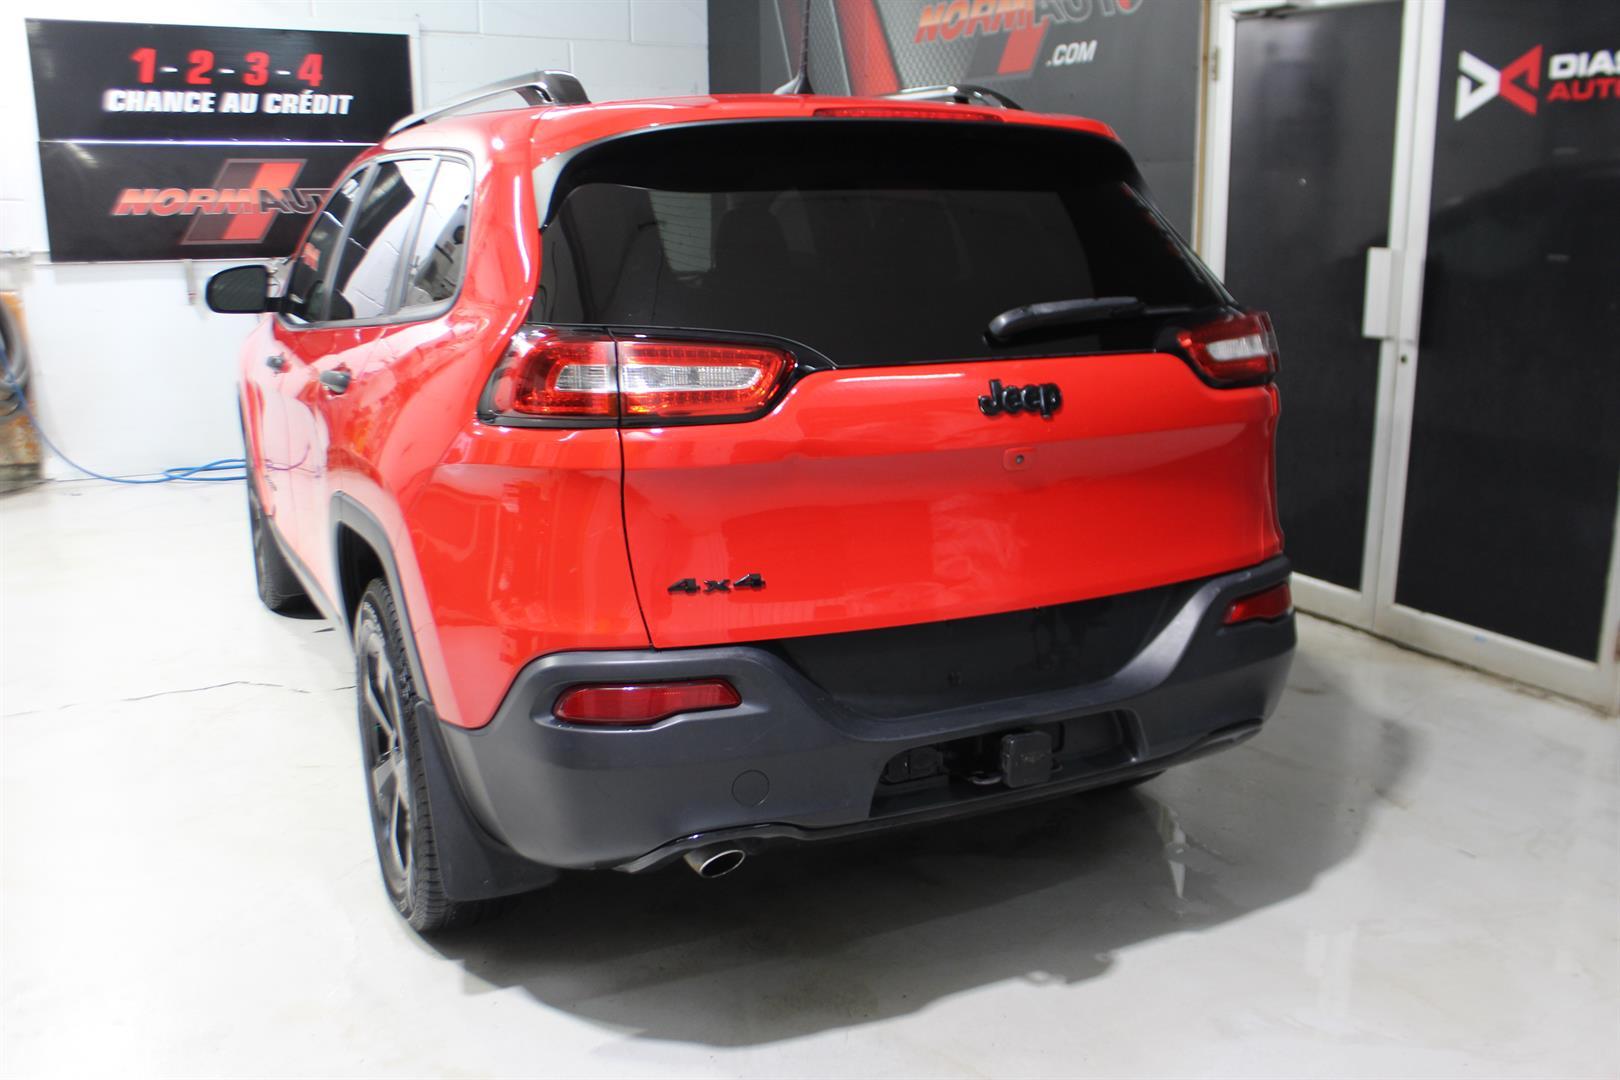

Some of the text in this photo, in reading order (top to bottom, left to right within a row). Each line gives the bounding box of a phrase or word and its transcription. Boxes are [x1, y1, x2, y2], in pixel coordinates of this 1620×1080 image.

[1045, 40, 1098, 67] .COM
[1548, 49, 1620, 80] DIA
[104, 90, 354, 115] CHANCE AU CRÉDIT
[1546, 76, 1620, 102] AUT
[978, 379, 1062, 420] Jeep
